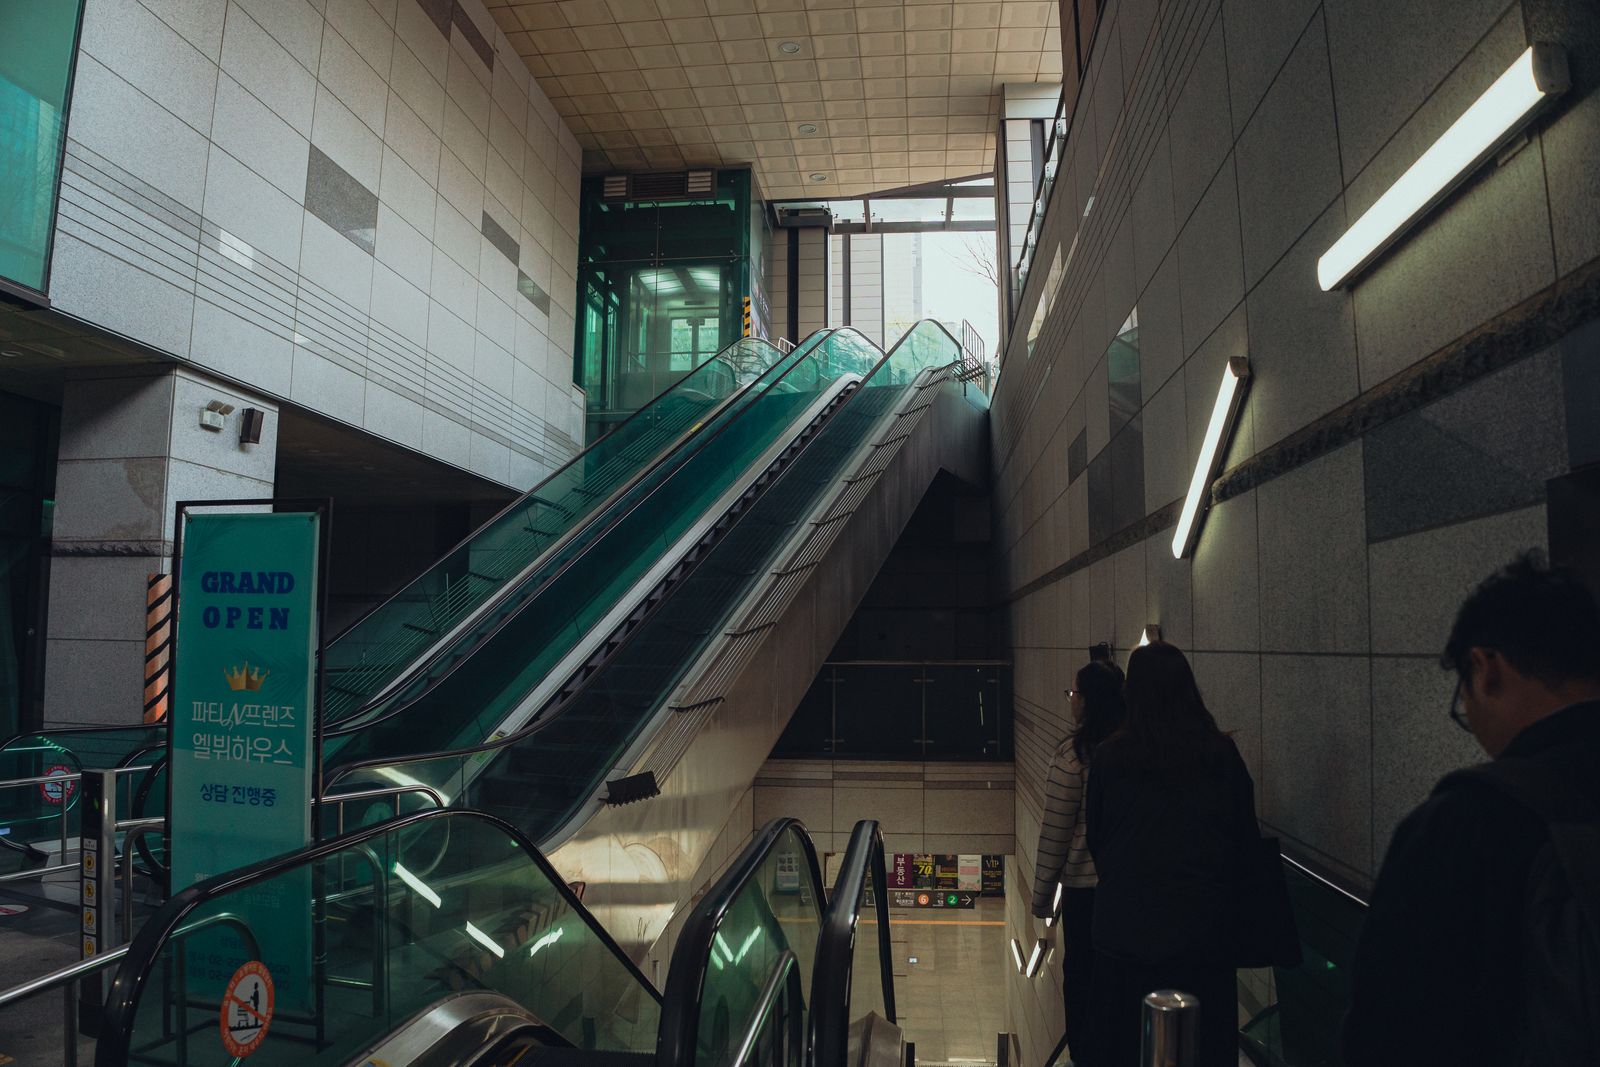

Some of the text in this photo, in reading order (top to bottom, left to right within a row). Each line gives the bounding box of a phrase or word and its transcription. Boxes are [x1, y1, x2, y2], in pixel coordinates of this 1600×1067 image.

[201, 571, 295, 594] GRAND
[202, 606, 290, 630] OPEN
[192, 732, 294, 765] 엘뷔하우스
[200, 783, 277, 808] 상담 진행중
[896, 854, 905, 885] 부동산
[985, 859, 1000, 868] VIP
